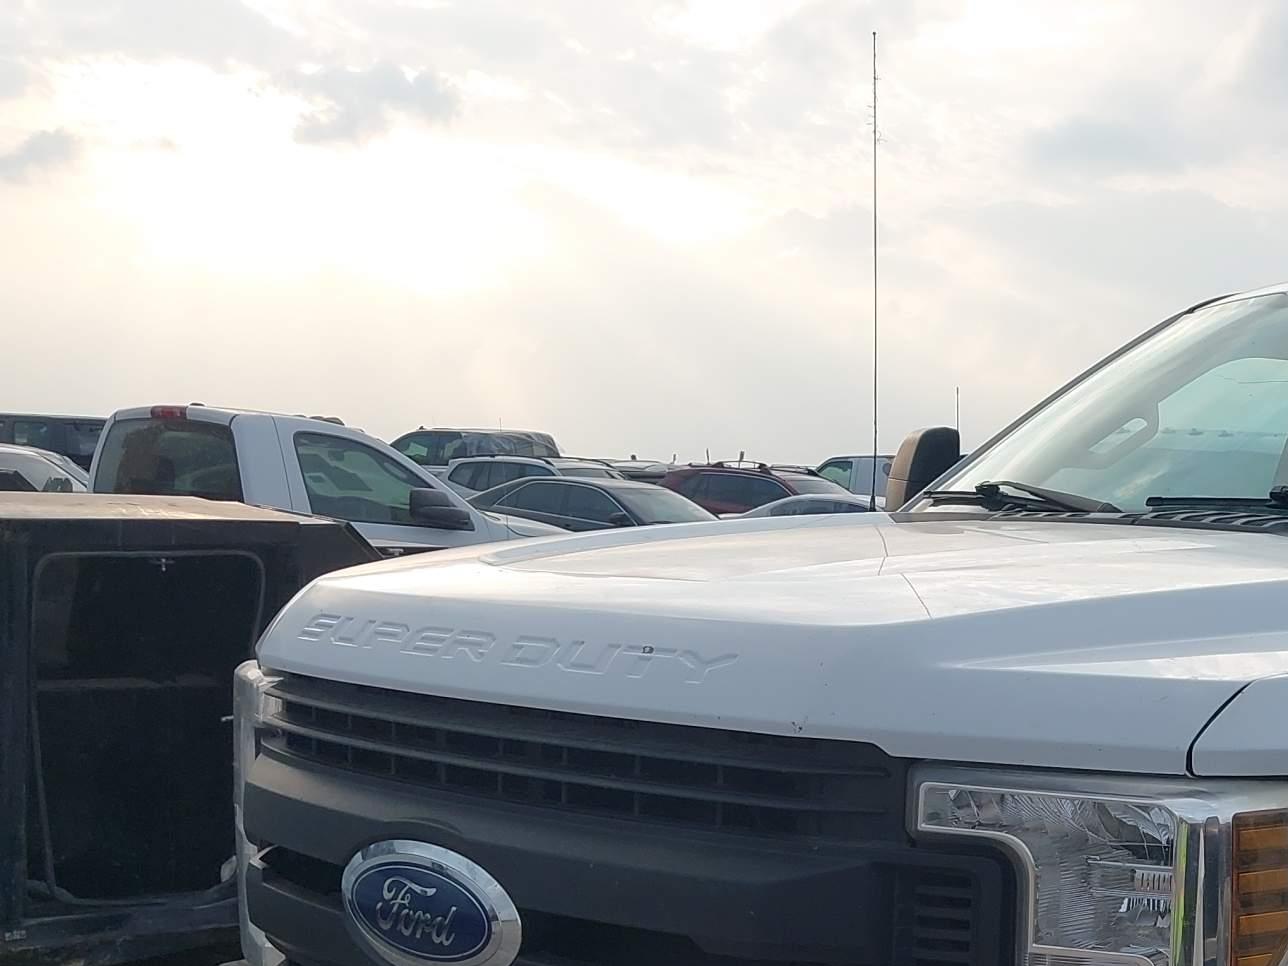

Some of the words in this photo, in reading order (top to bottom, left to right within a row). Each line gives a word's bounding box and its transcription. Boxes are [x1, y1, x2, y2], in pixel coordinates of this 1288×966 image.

[296, 612, 496, 663] SUPER
[500, 634, 739, 685] DUTY
[375, 875, 458, 947] Ford
